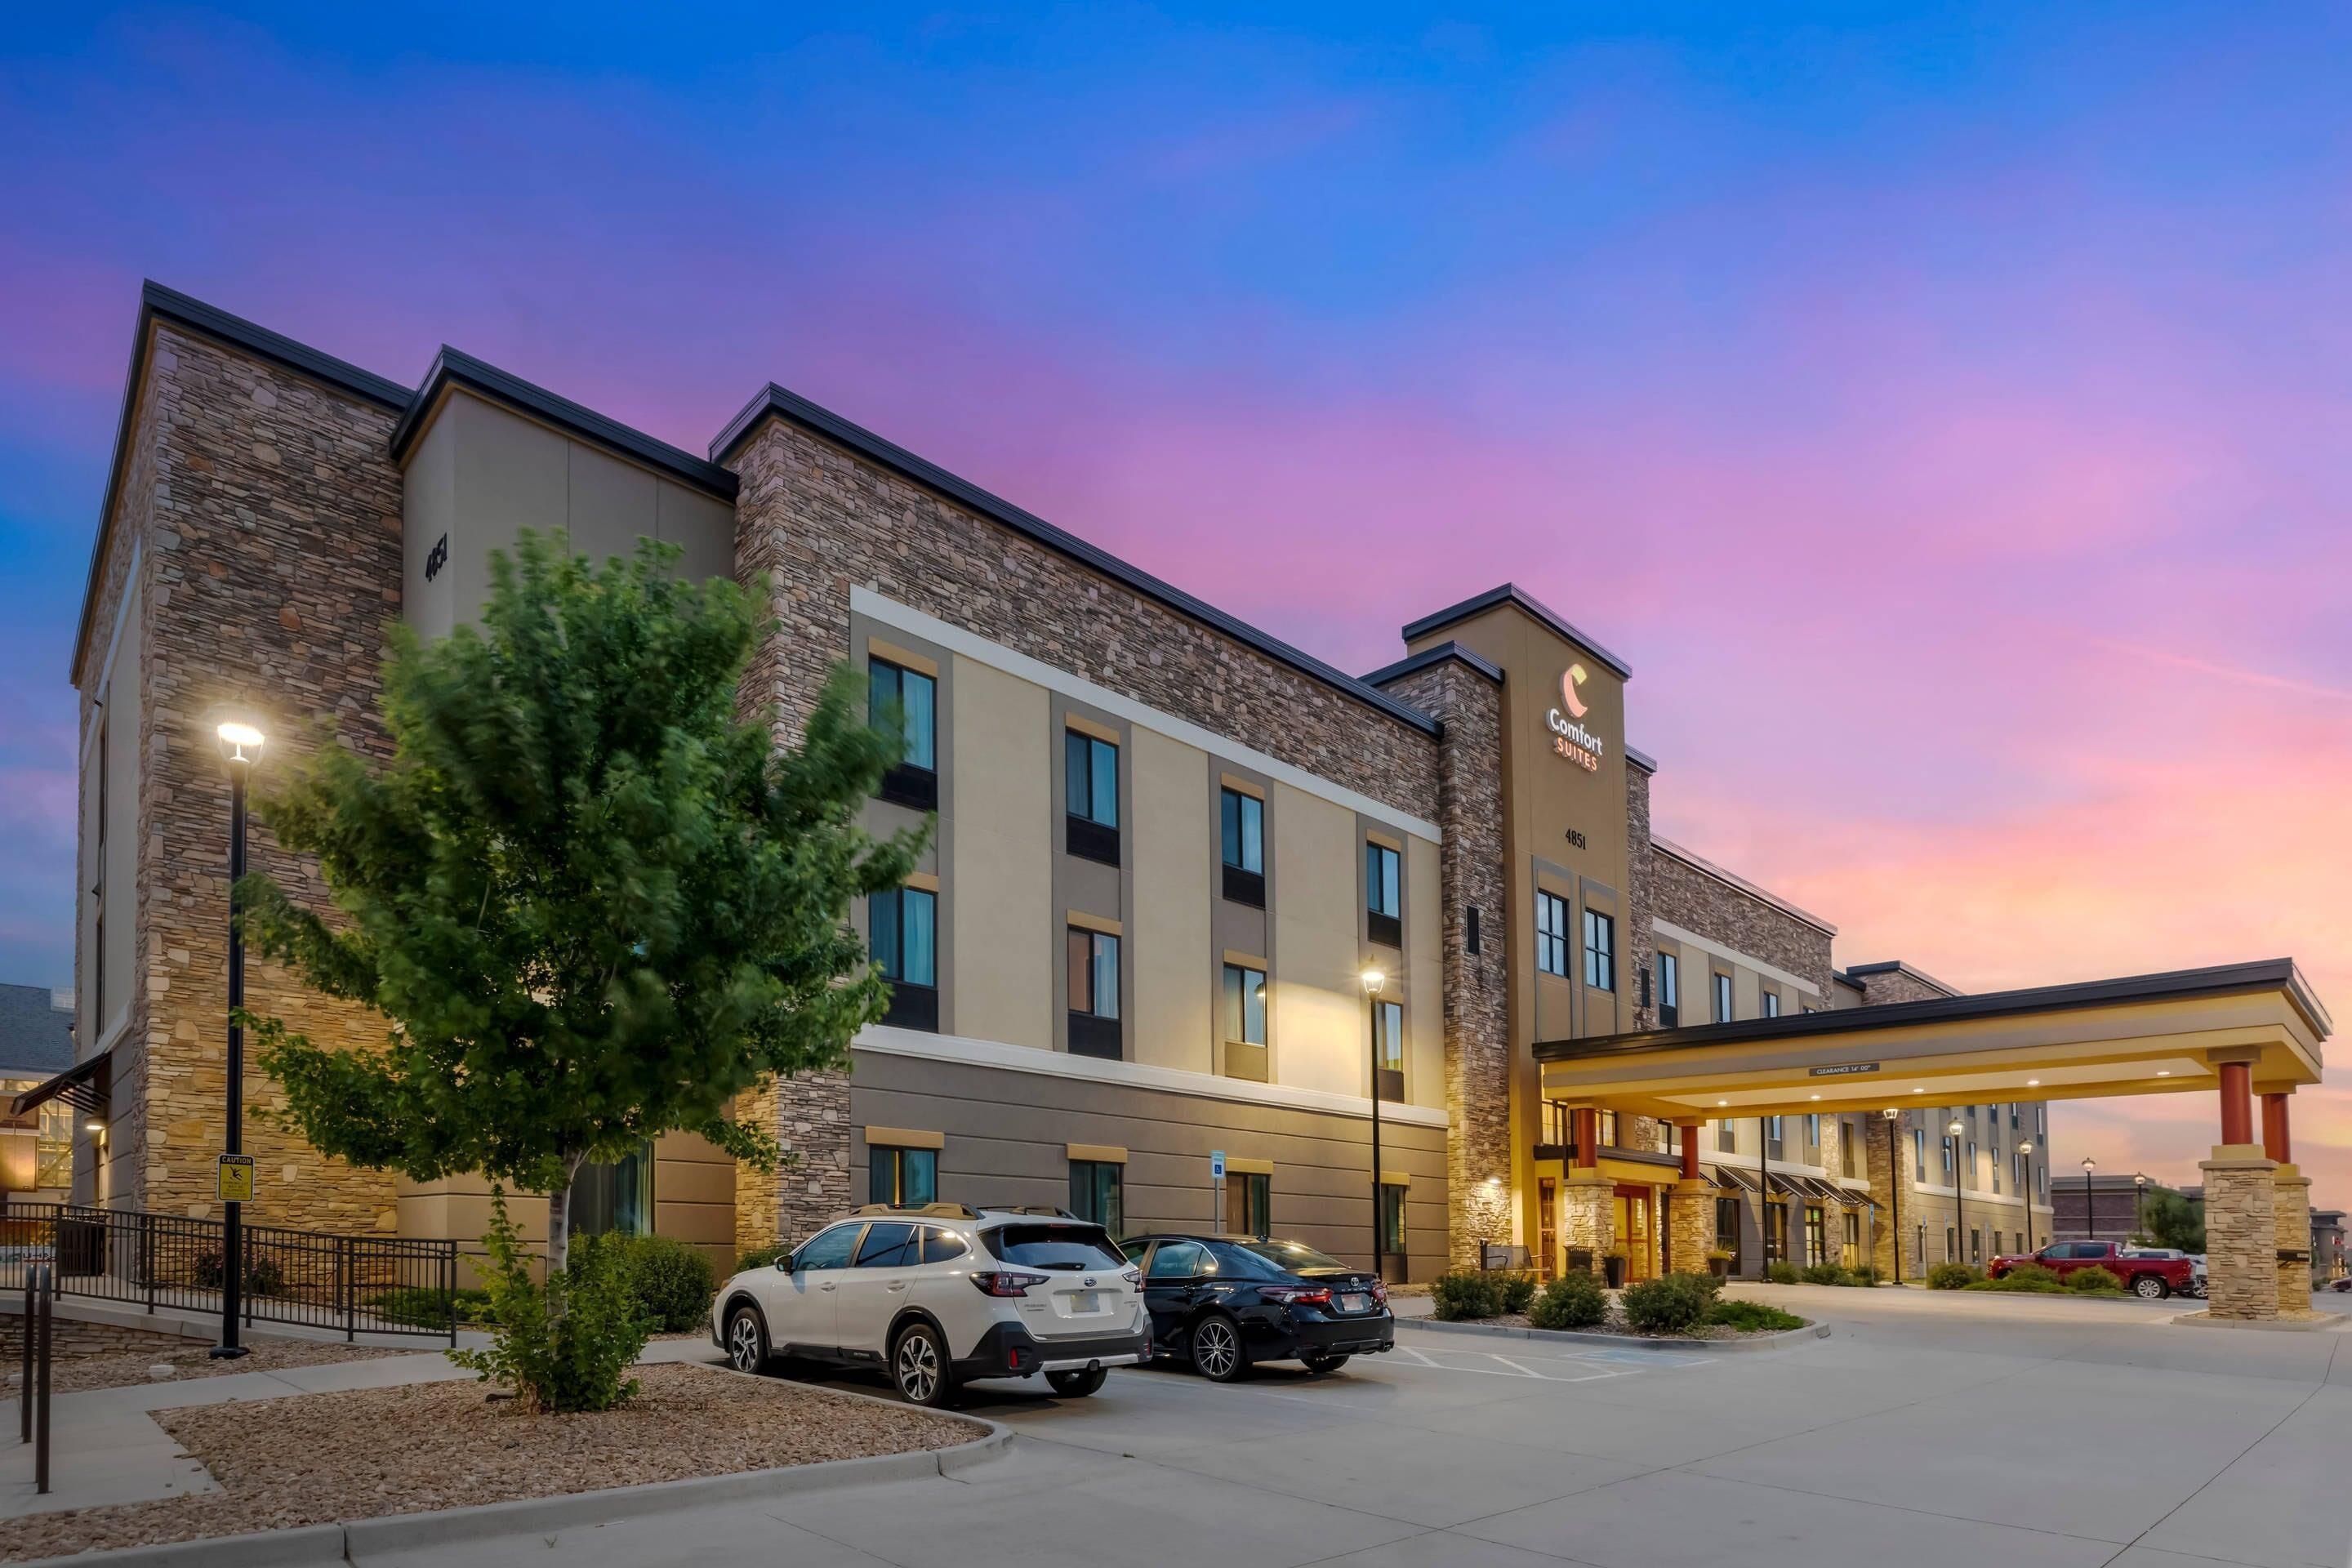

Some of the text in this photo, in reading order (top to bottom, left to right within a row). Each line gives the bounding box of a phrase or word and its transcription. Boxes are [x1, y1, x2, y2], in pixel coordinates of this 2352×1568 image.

[1548, 708, 1602, 756] Comfort
[1557, 737, 1597, 772] SUITES
[1565, 828, 1587, 850] 4851
[1816, 1067, 1849, 1075] CLEARANCE
[221, 1156, 252, 1164] CAUTION
